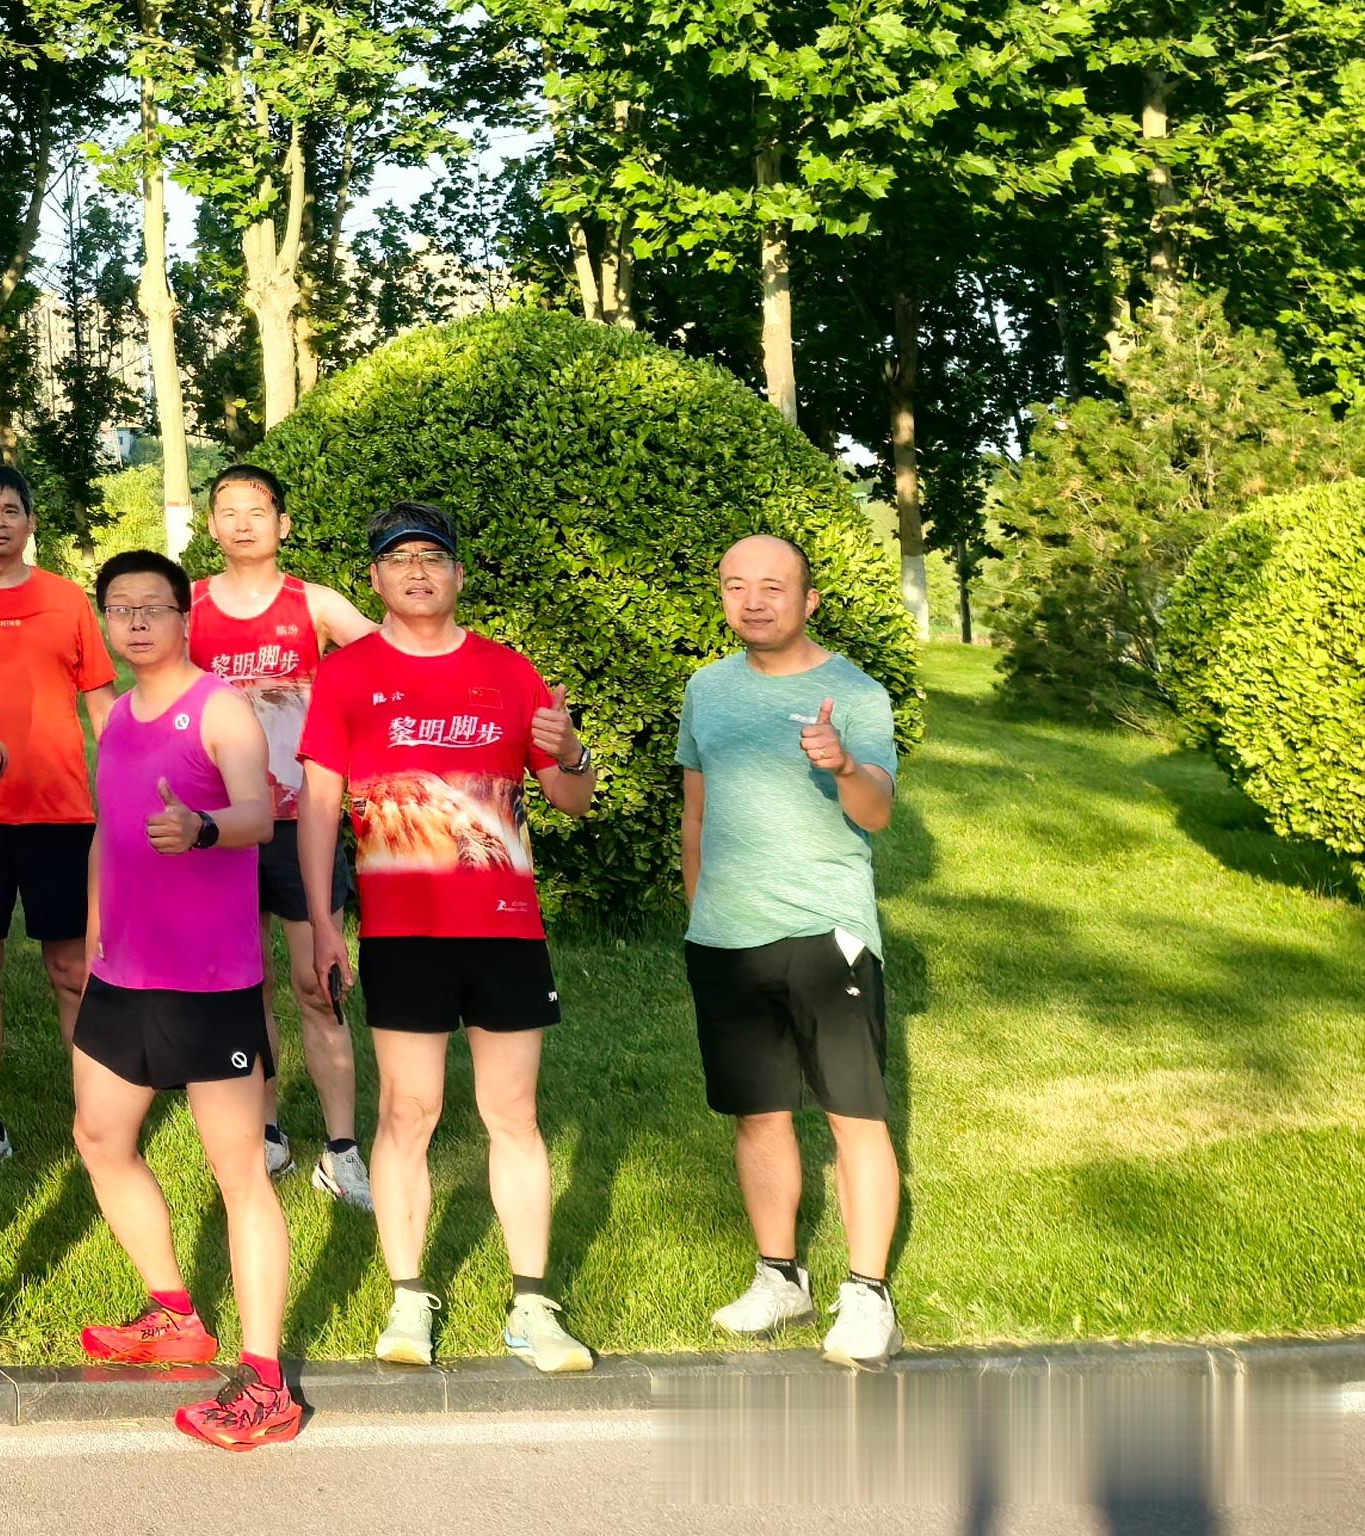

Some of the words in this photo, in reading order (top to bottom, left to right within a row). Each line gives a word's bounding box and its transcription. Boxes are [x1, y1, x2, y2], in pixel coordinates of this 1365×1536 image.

[211, 645, 300, 678] 黎明脚步
[388, 714, 503, 743] 黎明脚步
